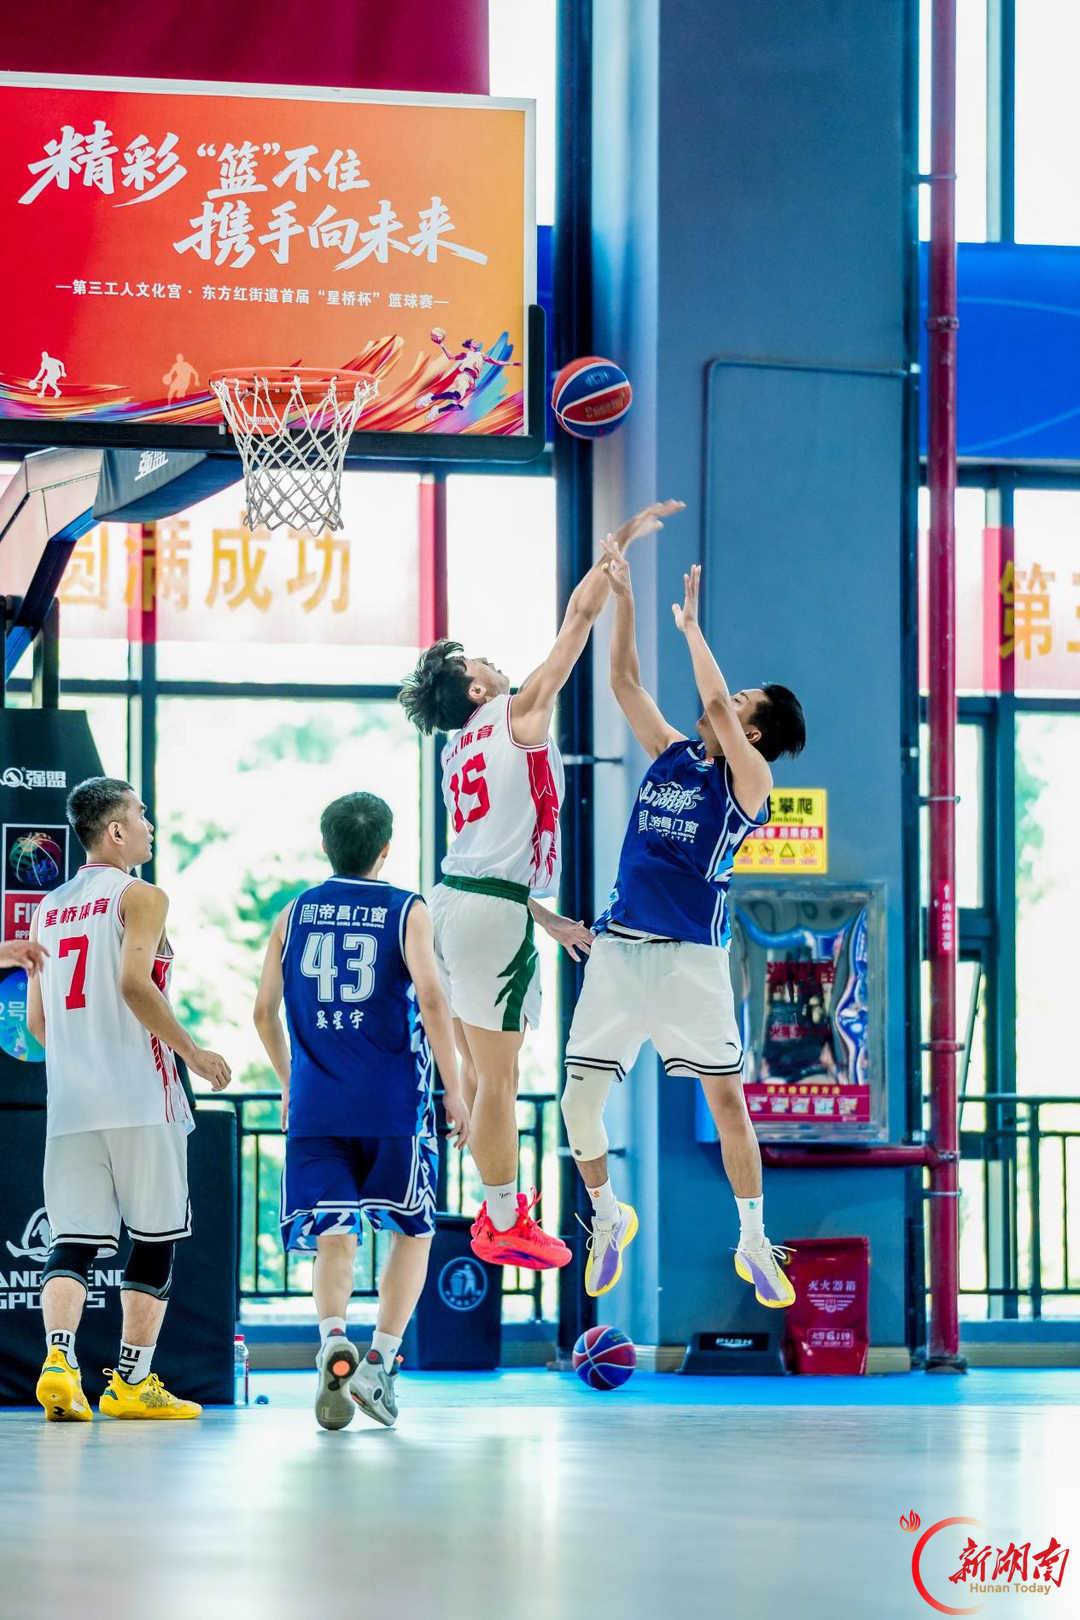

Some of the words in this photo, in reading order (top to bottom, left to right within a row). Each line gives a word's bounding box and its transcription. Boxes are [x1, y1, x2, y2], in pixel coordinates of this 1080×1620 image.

[18, 120, 371, 208] 精彩“篮”不住
[172, 196, 488, 272] 携手向未来
[25, 769, 67, 789] 强盟
[449, 752, 490, 834] 15
[45, 897, 110, 928] 星桥体育
[319, 904, 388, 924] 帝昌门窗
[59, 934, 89, 1010] 7
[300, 932, 378, 1003] 43
[808, 1280, 857, 1292] 灭火器箱
[715, 1337, 753, 1346] PUSH
